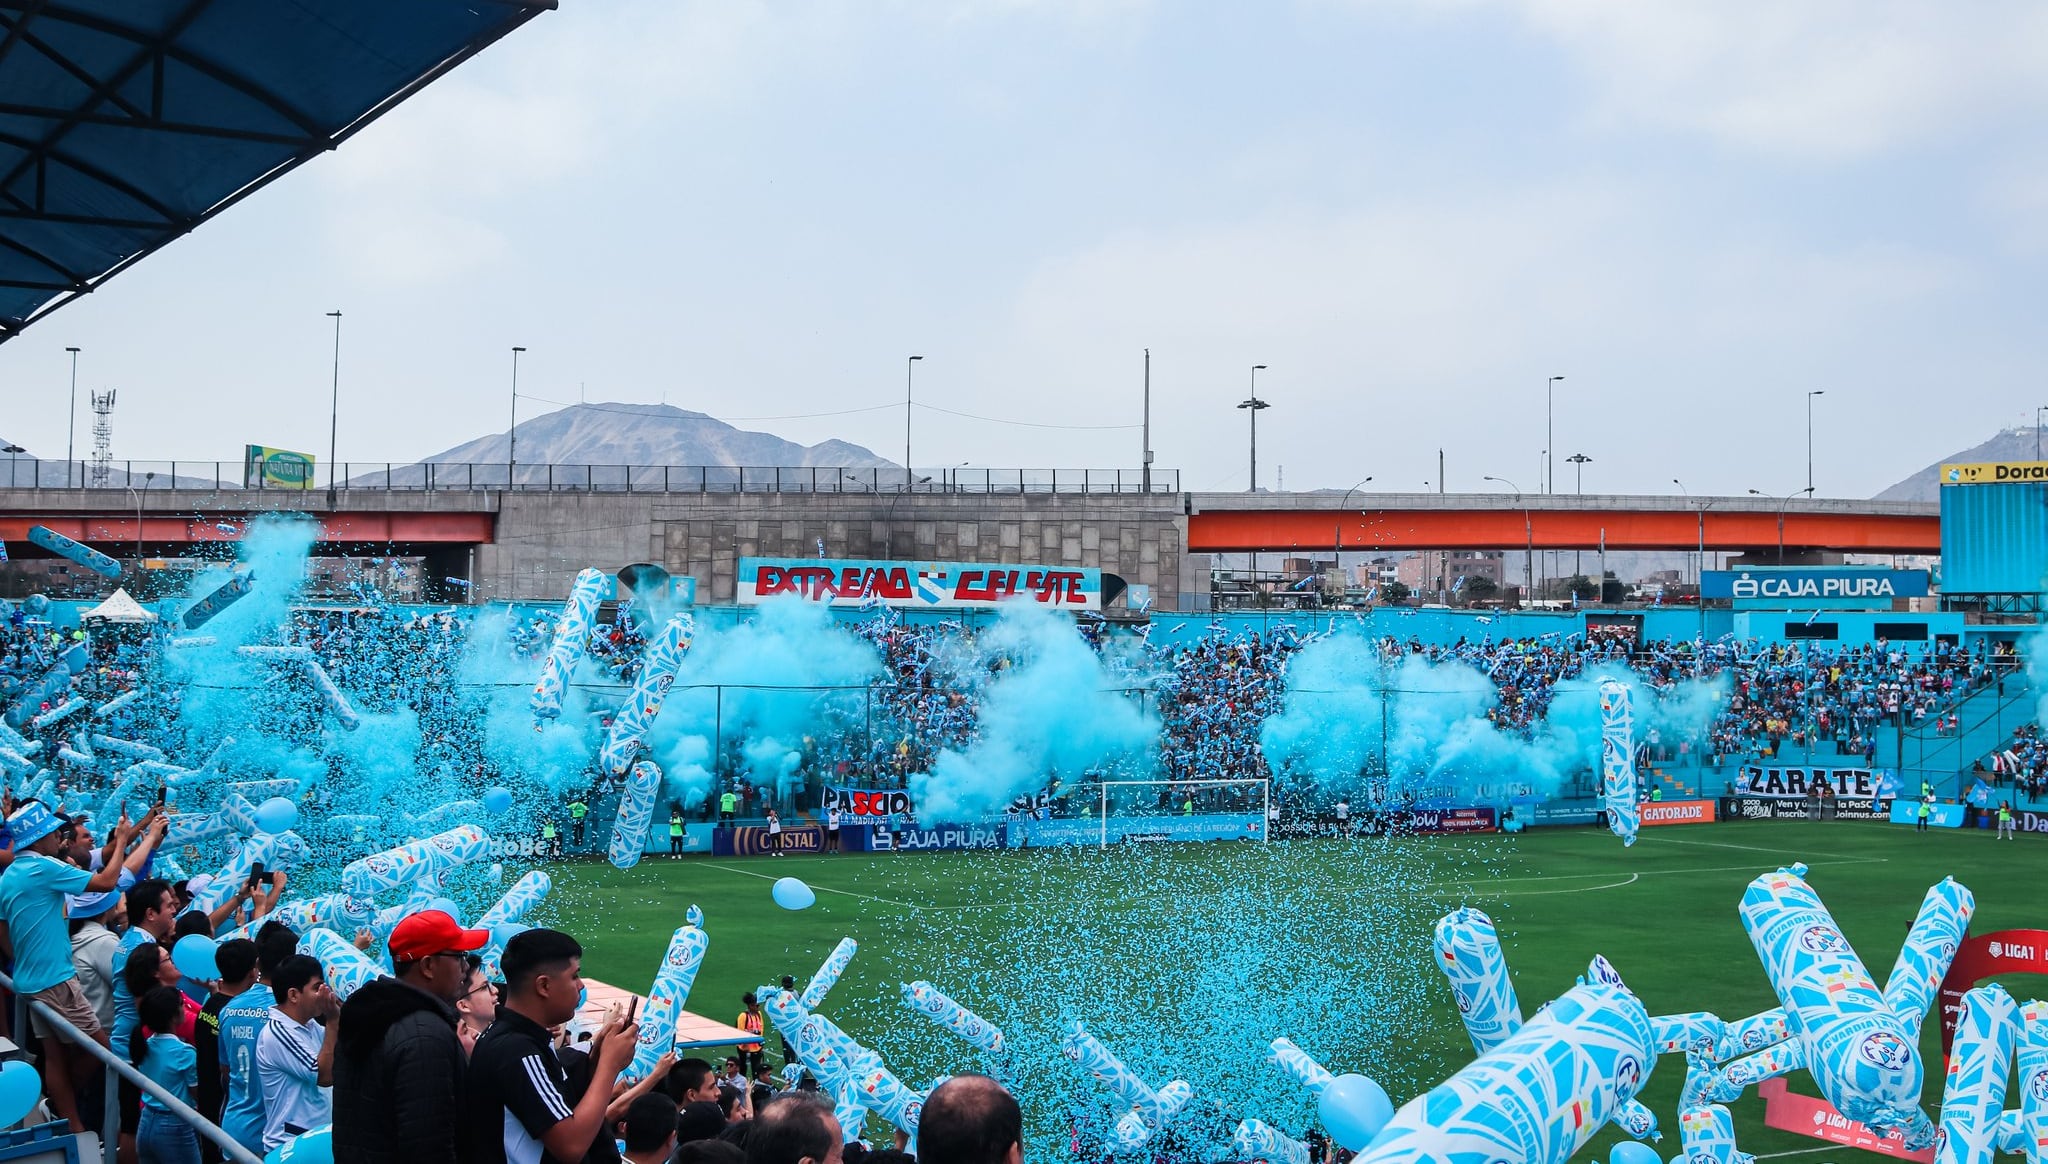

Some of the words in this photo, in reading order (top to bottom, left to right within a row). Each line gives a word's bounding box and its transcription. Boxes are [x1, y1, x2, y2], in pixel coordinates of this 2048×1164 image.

[755, 566, 913, 601] EXTREMO
[953, 570, 1088, 605] CELESTE
[1761, 578, 1819, 597] CAJA
[1823, 578, 1896, 597] PIURA
[1750, 767, 1873, 796] ZARATE
[1776, 800, 1793, 808] Ven
[1794, 802, 1800, 810] y
[1838, 800, 1847, 808] la
[1848, 800, 1889, 809] PaSCn,
[12, 806, 51, 836] RAZA
[1644, 807, 1703, 821] GATORADE
[1835, 810, 1891, 819] Joinnus.com
[898, 830, 941, 848] CAJA
[943, 830, 999, 849] PIURA
[2005, 943, 2034, 960] LIGA1
[225, 1007, 268, 1018] DoradoBe
[231, 1025, 255, 1040] MIGUEL
[1823, 1019, 1875, 1050] GVARDIA
[1826, 1113, 1853, 1130] LIGA1
